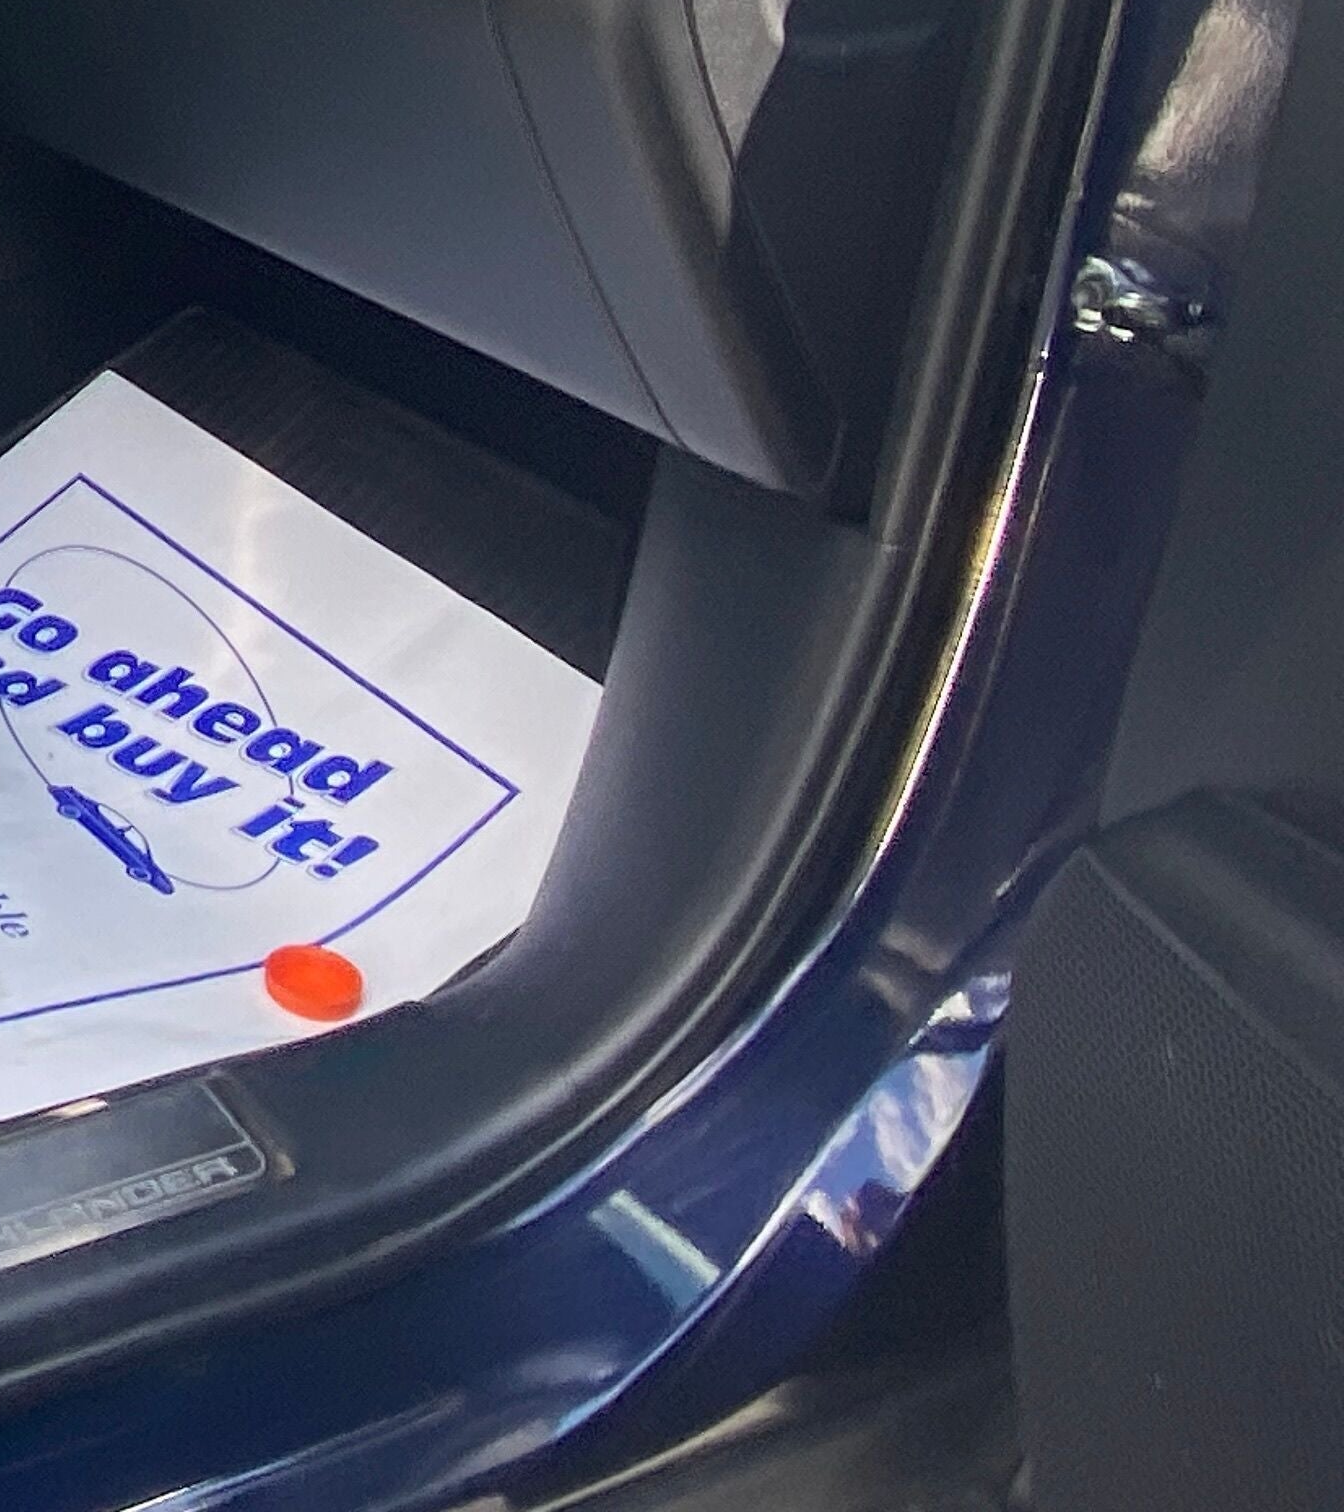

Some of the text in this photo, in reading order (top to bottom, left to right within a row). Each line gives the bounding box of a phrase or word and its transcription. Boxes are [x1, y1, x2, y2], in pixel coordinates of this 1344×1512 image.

[55, 702, 242, 806] buy
[236, 795, 381, 879] it!
[86, 649, 395, 805] ahead
